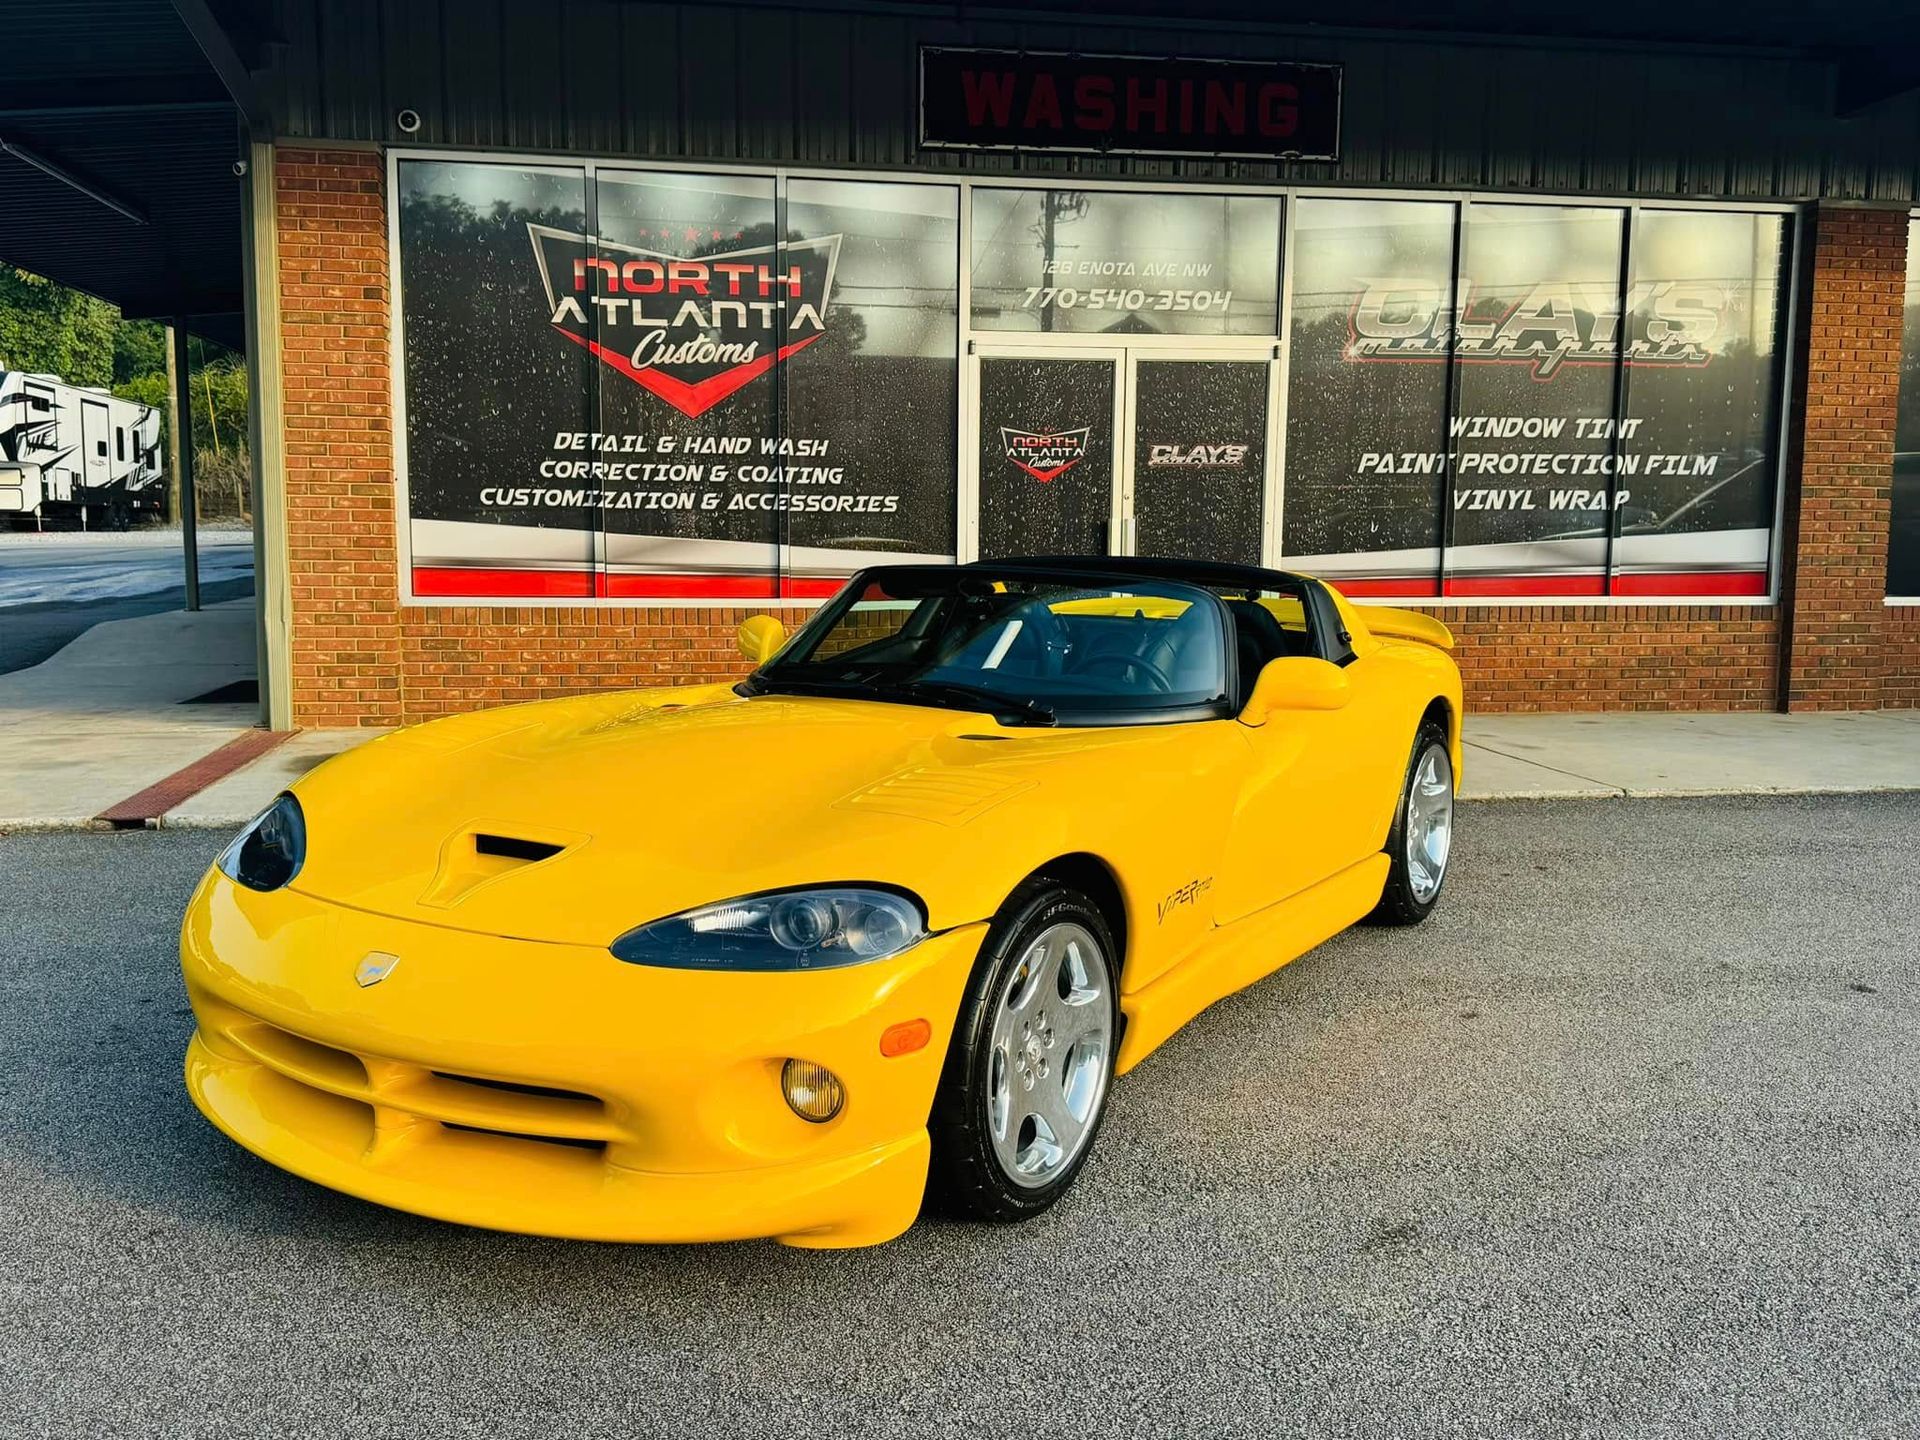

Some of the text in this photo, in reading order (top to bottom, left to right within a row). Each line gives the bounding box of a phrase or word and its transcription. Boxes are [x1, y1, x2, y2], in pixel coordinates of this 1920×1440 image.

[961, 70, 1299, 137] WASHING
[573, 257, 801, 298] NORTH
[1078, 262, 1135, 276] ENOTA
[1142, 263, 1178, 276] AVE
[1182, 264, 1212, 277] NW
[1021, 287, 1232, 311] 770-540-3504
[551, 295, 825, 331] ATLANTA
[630, 329, 759, 370] Customs
[1449, 416, 1643, 439] WINDOW TINT
[553, 432, 829, 457] DETAIL & HAND WASH
[1006, 447, 1084, 457] ATLANTA
[1013, 437, 1078, 447] NORTH
[539, 461, 844, 485] CORRECTION & COATING
[1357, 453, 1718, 476] PAINT PROTECTION FILM
[479, 488, 900, 513] CUSTOMIZATION & ACCESSORIES
[1453, 489, 1631, 511] VINYL WRAP
